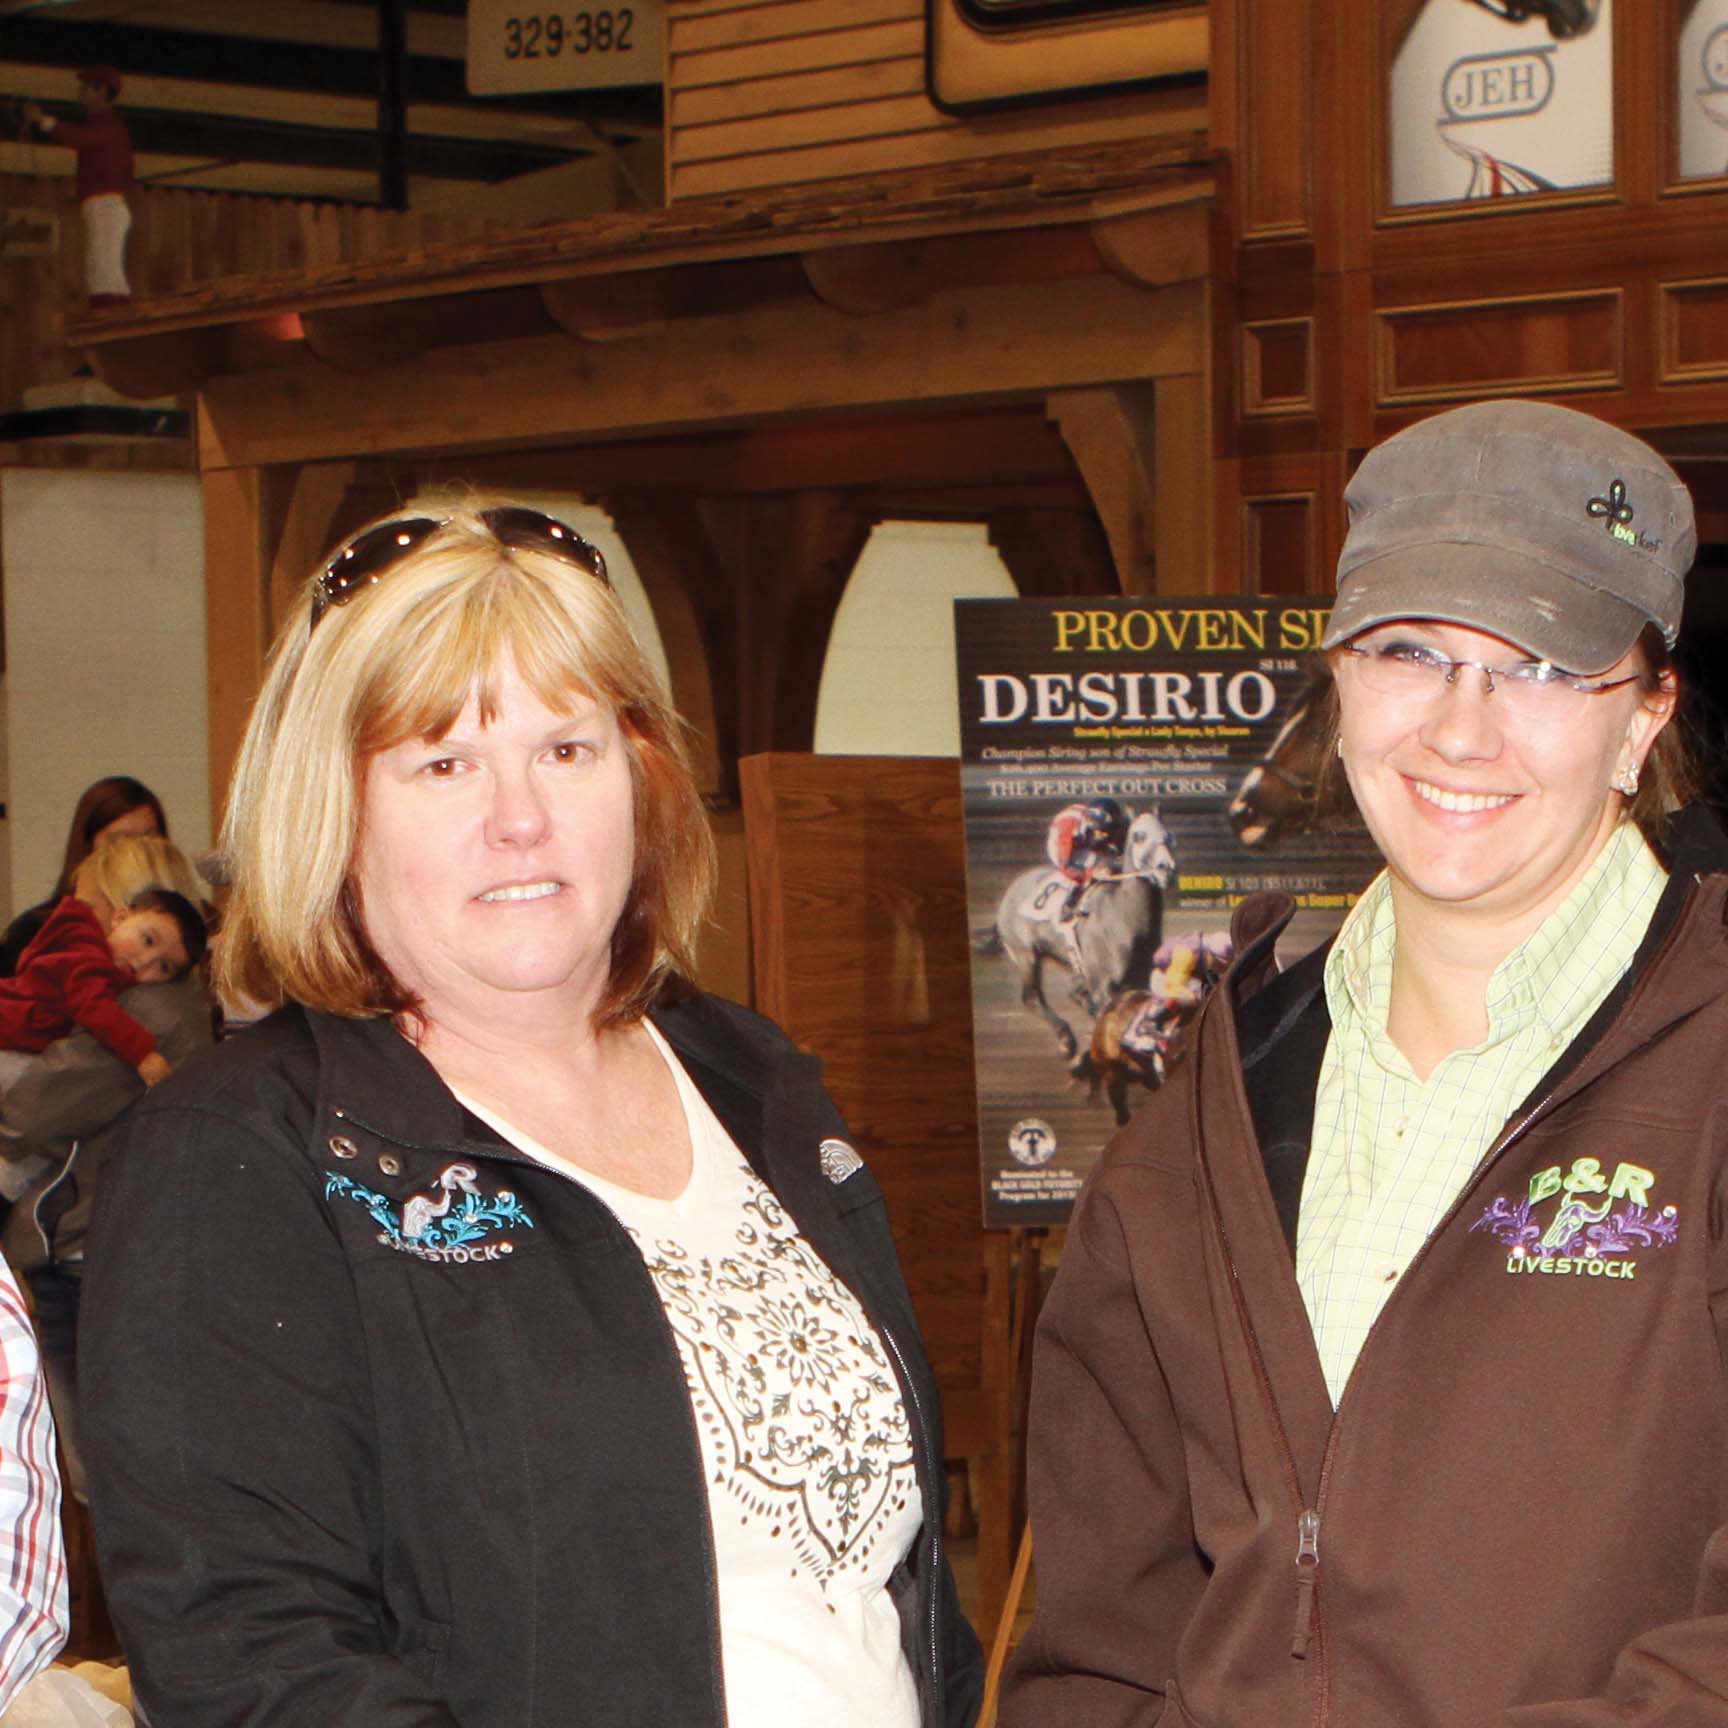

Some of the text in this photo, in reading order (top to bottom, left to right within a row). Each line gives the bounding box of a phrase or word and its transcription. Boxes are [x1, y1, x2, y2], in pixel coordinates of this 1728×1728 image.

[1456, 62, 1536, 109] JEH
[1051, 609, 1268, 652] PROVEN
[977, 670, 1276, 723] DESIRIO
[987, 777, 1227, 797] THE PERFECT OUT CROSS
[1035, 881, 1060, 910] 8
[1529, 1157, 1655, 1208] B&R
[1506, 1255, 1637, 1280] LIVESTOCK
